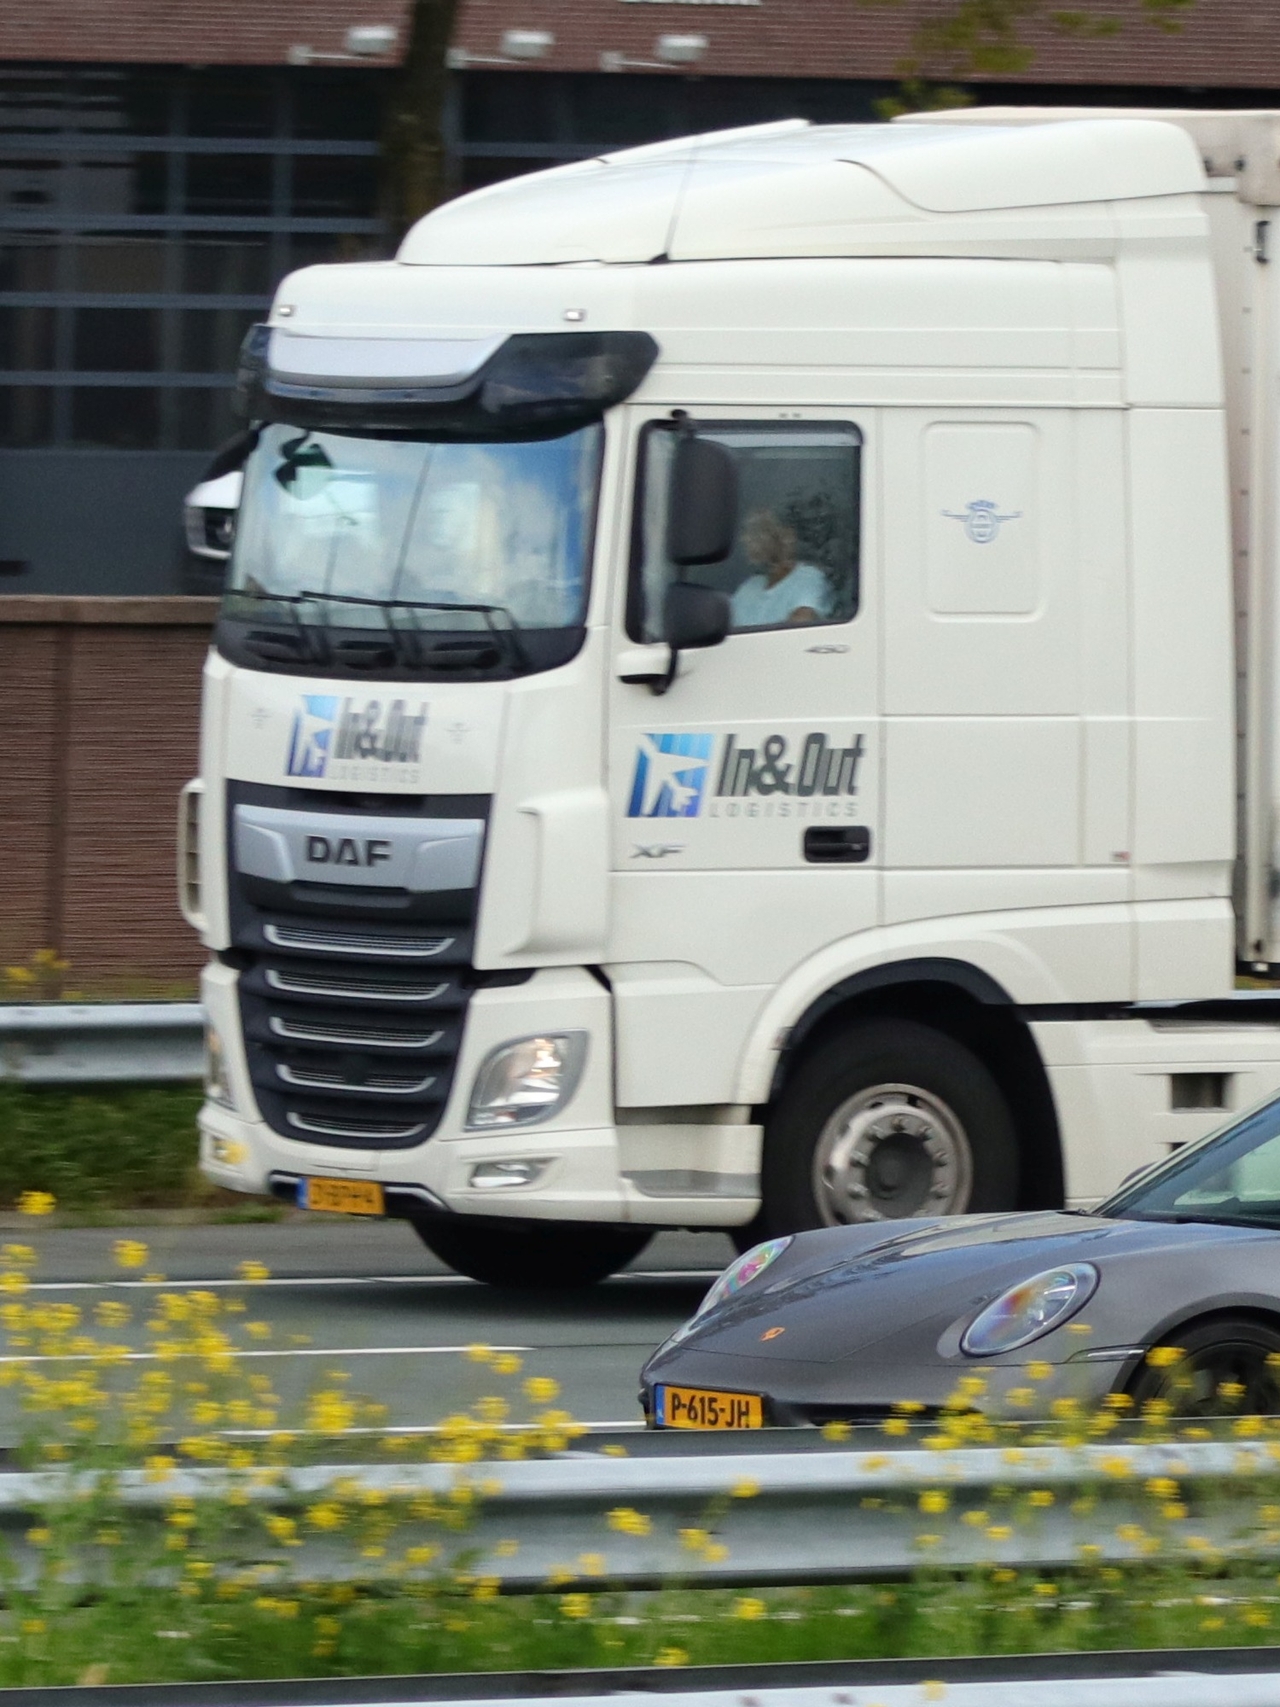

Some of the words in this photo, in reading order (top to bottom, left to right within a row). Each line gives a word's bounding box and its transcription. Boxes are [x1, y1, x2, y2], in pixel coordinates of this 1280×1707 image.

[714, 733, 866, 797] In&Out
[709, 802, 859, 818] LOGISTICS
[305, 835, 392, 867] DAF
[671, 1393, 750, 1428] P-615-JH
